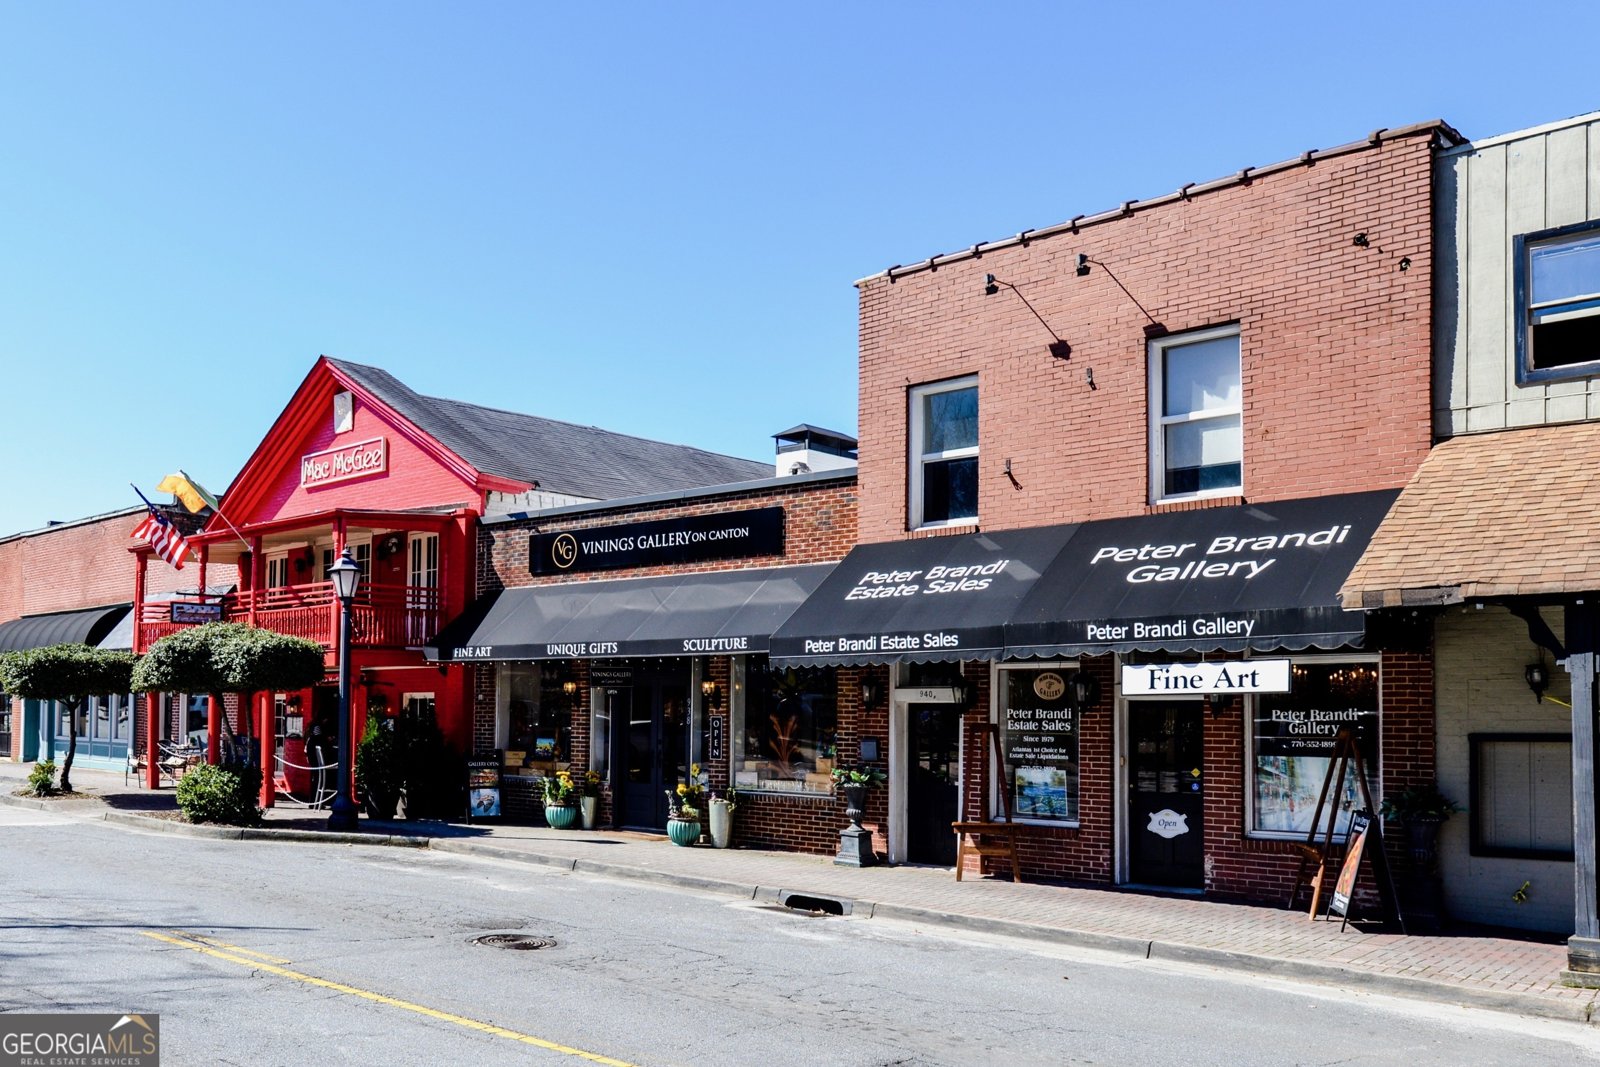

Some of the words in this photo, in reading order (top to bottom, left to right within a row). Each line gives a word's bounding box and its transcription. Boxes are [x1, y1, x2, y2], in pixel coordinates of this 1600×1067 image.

[303, 459, 330, 485] Mac
[332, 445, 381, 476] McGee
[582, 536, 634, 555] VININGS
[637, 530, 692, 549] GALLERY
[692, 531, 707, 542] ON
[708, 527, 749, 540] CANTON
[1090, 542, 1196, 564] Peter
[1206, 525, 1351, 555] Brandi
[858, 570, 923, 586] Peter
[924, 560, 1010, 580] Brandi
[1126, 558, 1276, 584] Gallery
[844, 584, 920, 601] Estate
[923, 577, 993, 595] Sales
[1087, 624, 1129, 640] Peter
[1133, 619, 1187, 638] Brandi
[1192, 616, 1255, 637] Gallery
[453, 647, 474, 658] FINE
[474, 646, 493, 657] ART
[546, 643, 586, 657] UNIQUE
[589, 642, 618, 654] GIFTS
[683, 637, 748, 651] SCULPTURE
[805, 639, 836, 654] Peter
[838, 636, 877, 651] Brandi
[880, 635, 920, 650] Estate
[923, 632, 959, 647] Sales
[1148, 668, 1203, 690] Fine
[1213, 667, 1260, 688] Art
[1006, 708, 1033, 719] Peter
[1035, 707, 1072, 719] Brandi
[1271, 709, 1306, 721] Peter
[1310, 708, 1358, 721] Brandi
[1007, 720, 1039, 731] Estate
[1041, 720, 1071, 731] Sales
[1288, 721, 1340, 737] Gallery
[712, 720, 720, 756] OPEN
[1022, 735, 1039, 743] Since
[1158, 819, 1177, 829] Open
